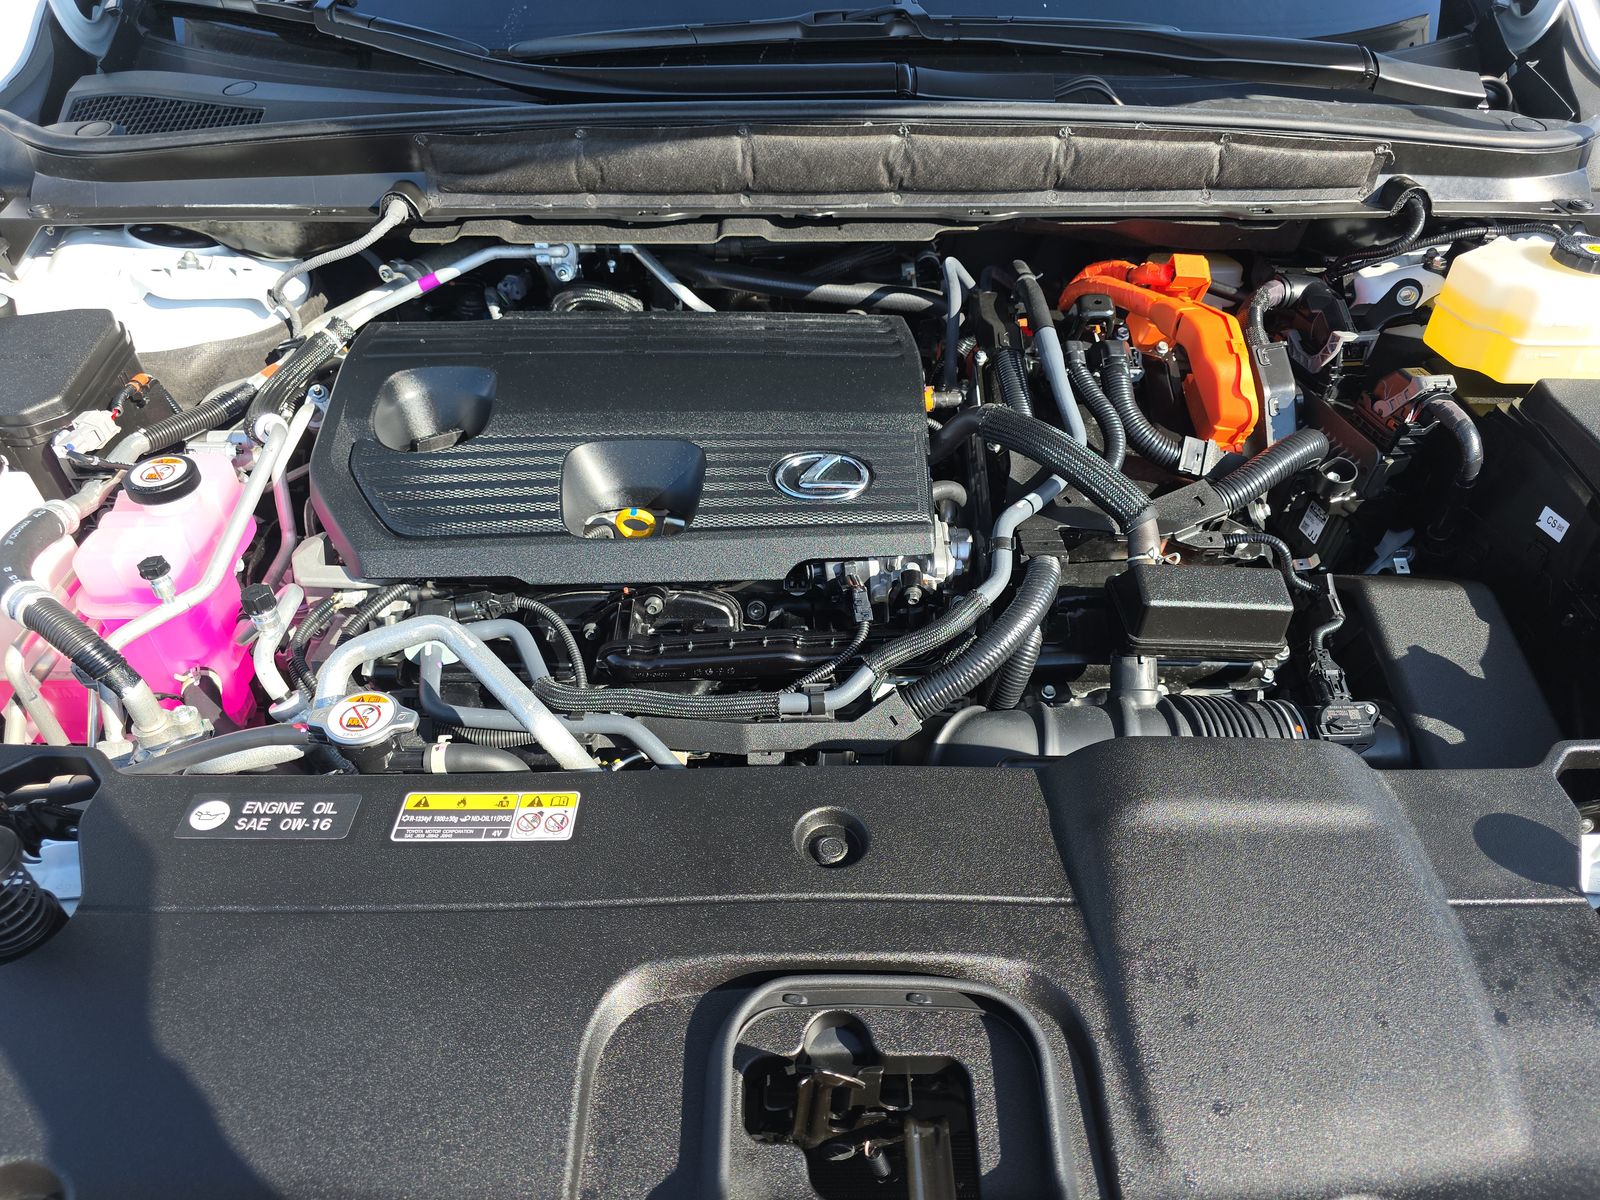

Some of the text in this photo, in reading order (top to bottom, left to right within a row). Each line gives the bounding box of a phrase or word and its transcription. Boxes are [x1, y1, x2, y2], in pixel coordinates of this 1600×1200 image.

[1546, 515, 1558, 528] CS
[241, 801, 338, 815] ENGINE OIL
[234, 817, 333, 831] SAE 0W-16
[491, 829, 503, 837] 4V
